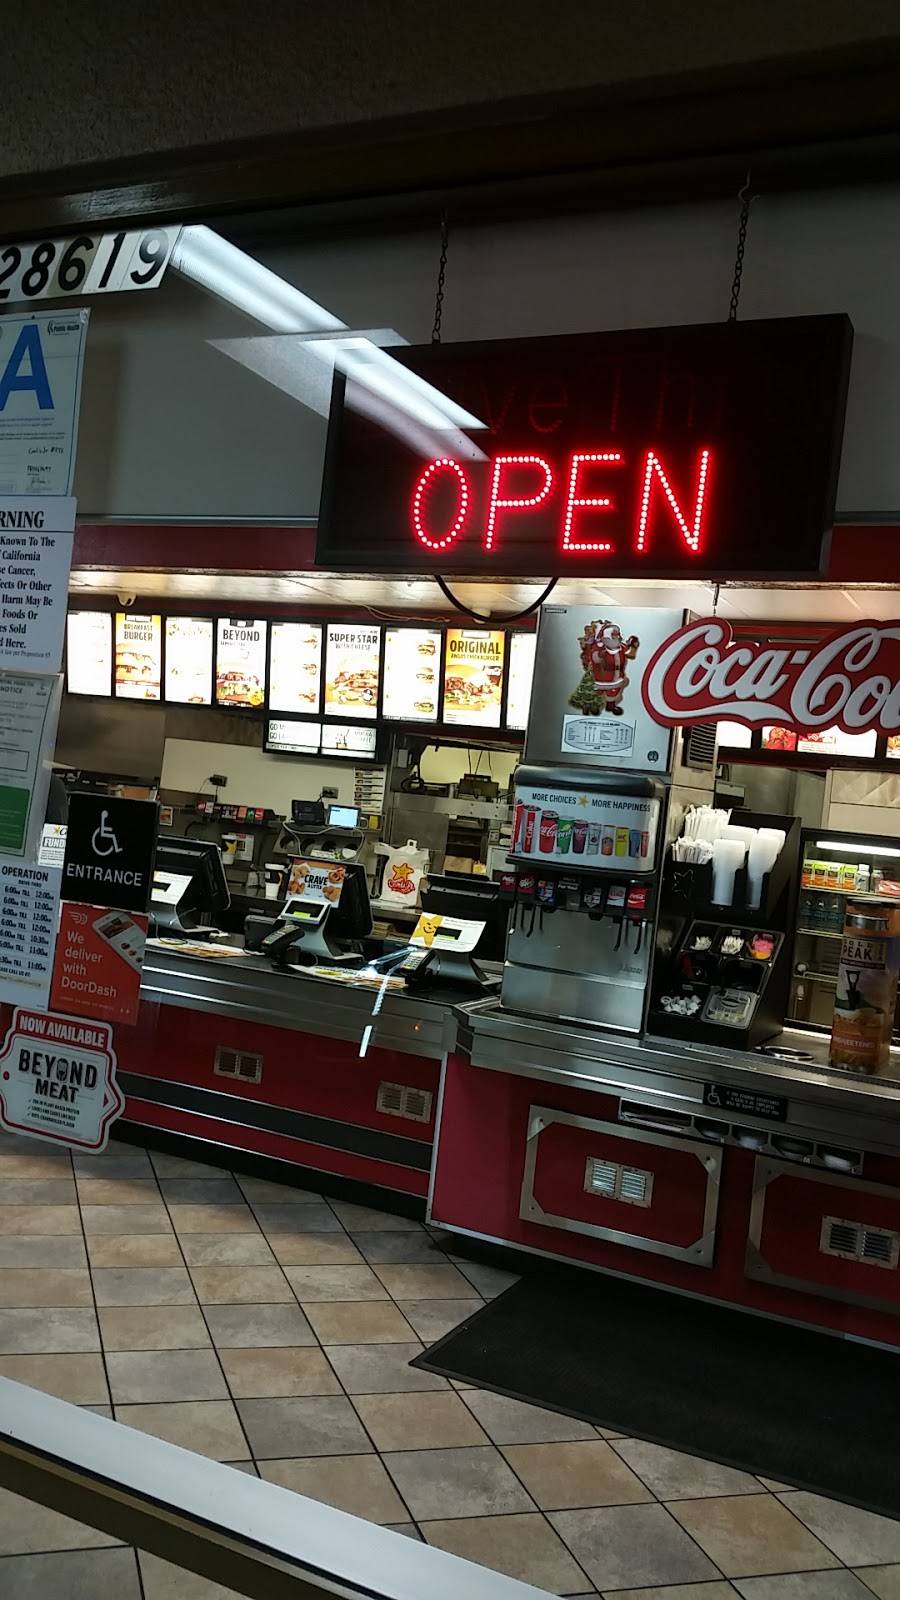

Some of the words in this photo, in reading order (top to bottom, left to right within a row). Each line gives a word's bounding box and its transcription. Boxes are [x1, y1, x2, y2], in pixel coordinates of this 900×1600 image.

[0, 229, 169, 299] 28619
[0, 324, 55, 410] A
[413, 449, 711, 550] OPEN
[29, 536, 39, 546] To
[41, 536, 56, 547] The
[2, 550, 41, 561] California
[8, 565, 36, 576] Cancer,
[17, 580, 28, 590] Or
[29, 581, 53, 591] Other
[1, 594, 23, 604] Harm
[25, 595, 42, 607] May
[43, 596, 54, 606] Be
[2, 609, 26, 619] Foods
[28, 610, 39, 620] Or
[9, 624, 27, 634] Sold
[223, 629, 260, 641] BEYOND
[123, 631, 153, 641] BURGER
[329, 633, 356, 643] SUPER
[357, 635, 378, 644] STAR
[5, 638, 27, 648] Here.
[449, 639, 502, 655] ORIGINAL
[531, 792, 549, 802] MORE
[549, 794, 577, 805] CHOICES
[591, 799, 612, 809] MORE
[612, 800, 651, 812] HAPPINESS
[2, 866, 49, 882] OPERATION
[66, 862, 143, 887] ENTRANCE
[304, 874, 329, 886] CRAVE
[67, 930, 85, 944] We
[64, 946, 104, 963] deliver
[843, 944, 873, 961] PEAK
[63, 962, 87, 975] with
[61, 975, 117, 998] DoorDash
[19, 1015, 46, 1034] NOW
[46, 1021, 105, 1048] AVAILABLE
[18, 1048, 98, 1088] BEYOND
[35, 1078, 79, 1104] MEAT
